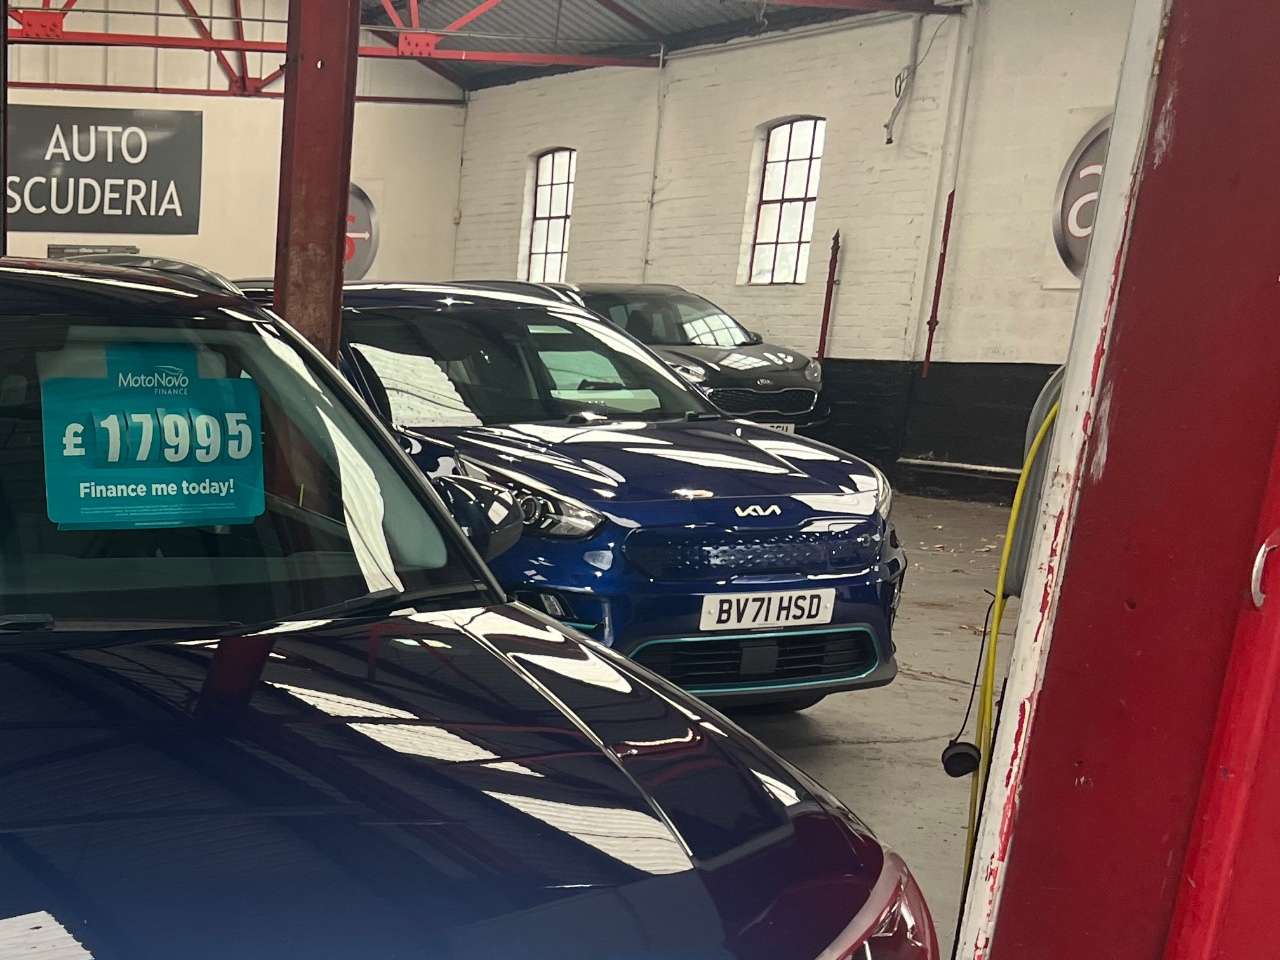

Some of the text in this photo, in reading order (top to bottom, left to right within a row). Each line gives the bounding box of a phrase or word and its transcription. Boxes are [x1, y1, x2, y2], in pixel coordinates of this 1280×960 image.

[44, 124, 148, 164] AUTO
[7, 175, 183, 217] SCUDERIA
[1067, 164, 1105, 239] a
[118, 372, 189, 388] MotoNovo
[154, 387, 188, 396] FINANCE
[62, 412, 253, 463] £ 17995
[79, 478, 235, 498] Finance me today!
[716, 594, 822, 625] BV71 HSD
